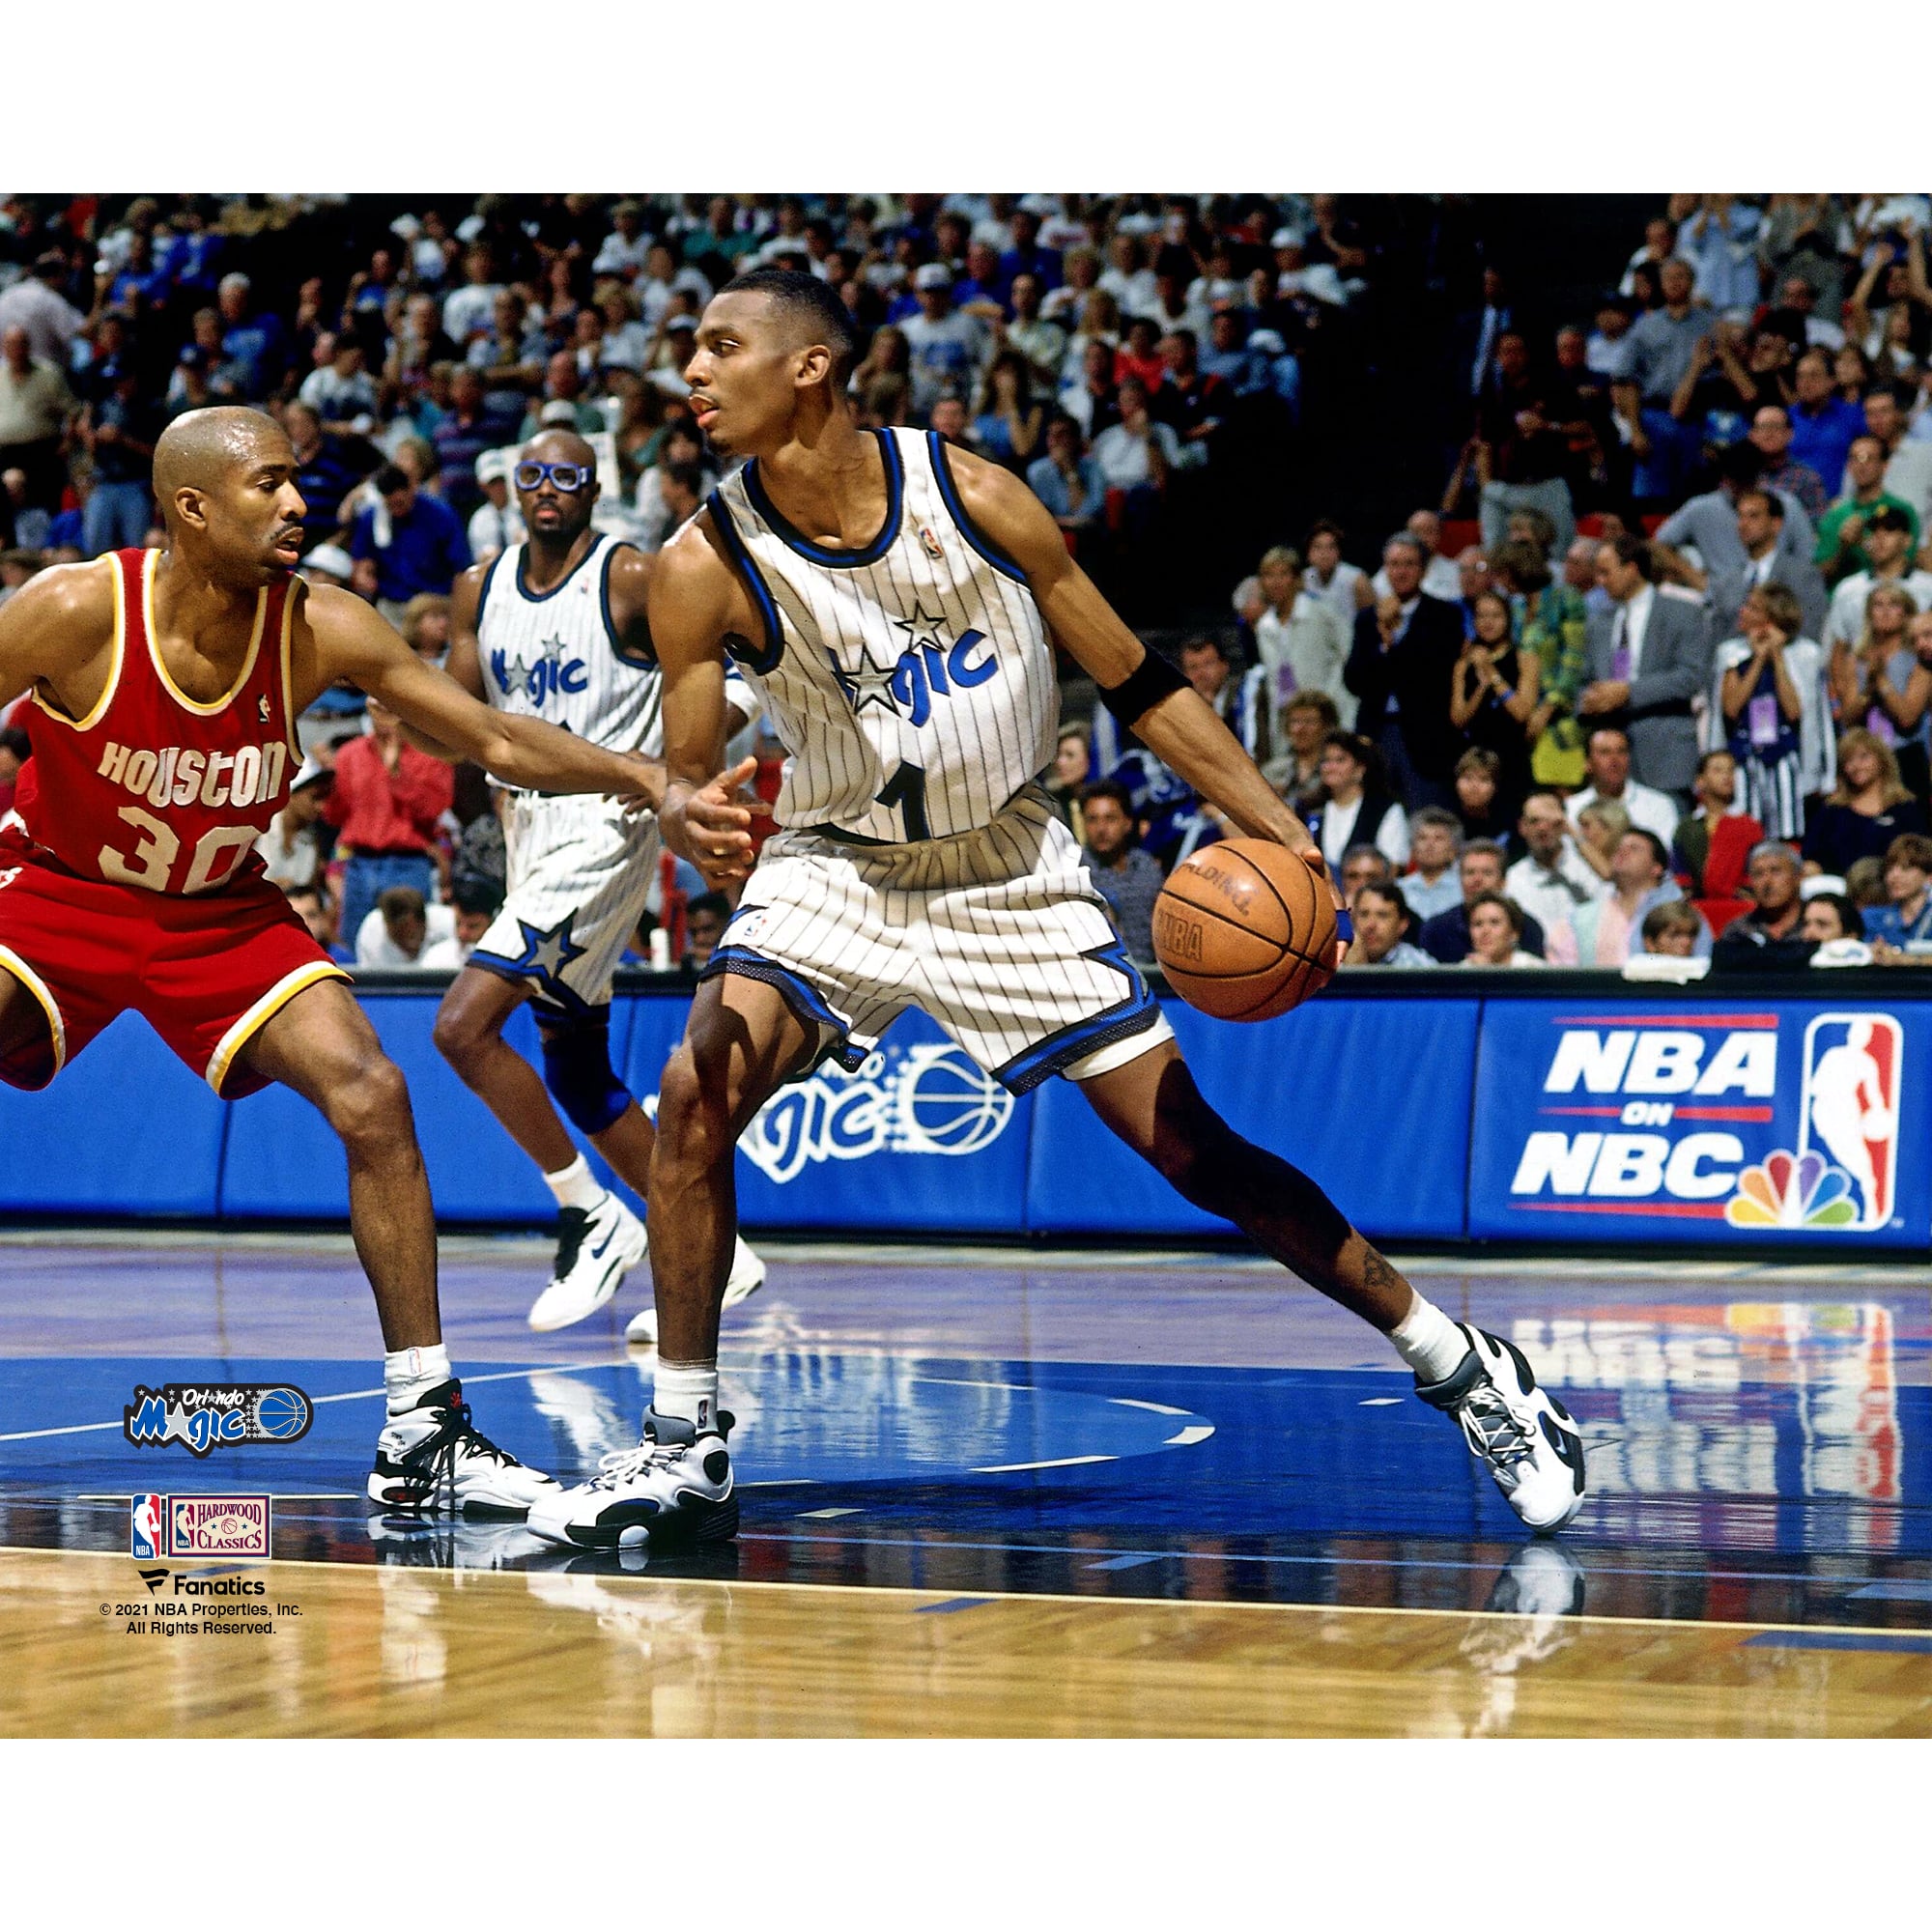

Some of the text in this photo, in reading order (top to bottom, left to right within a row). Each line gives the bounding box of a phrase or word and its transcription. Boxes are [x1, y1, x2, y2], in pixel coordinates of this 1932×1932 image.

[874, 759, 930, 844] 1
[98, 806, 263, 894] 30
[1175, 862, 1259, 917] ALDING
[1543, 1030, 1777, 1097] NBA
[1620, 1101, 1675, 1126] ON
[1510, 1131, 1744, 1199] NBC
